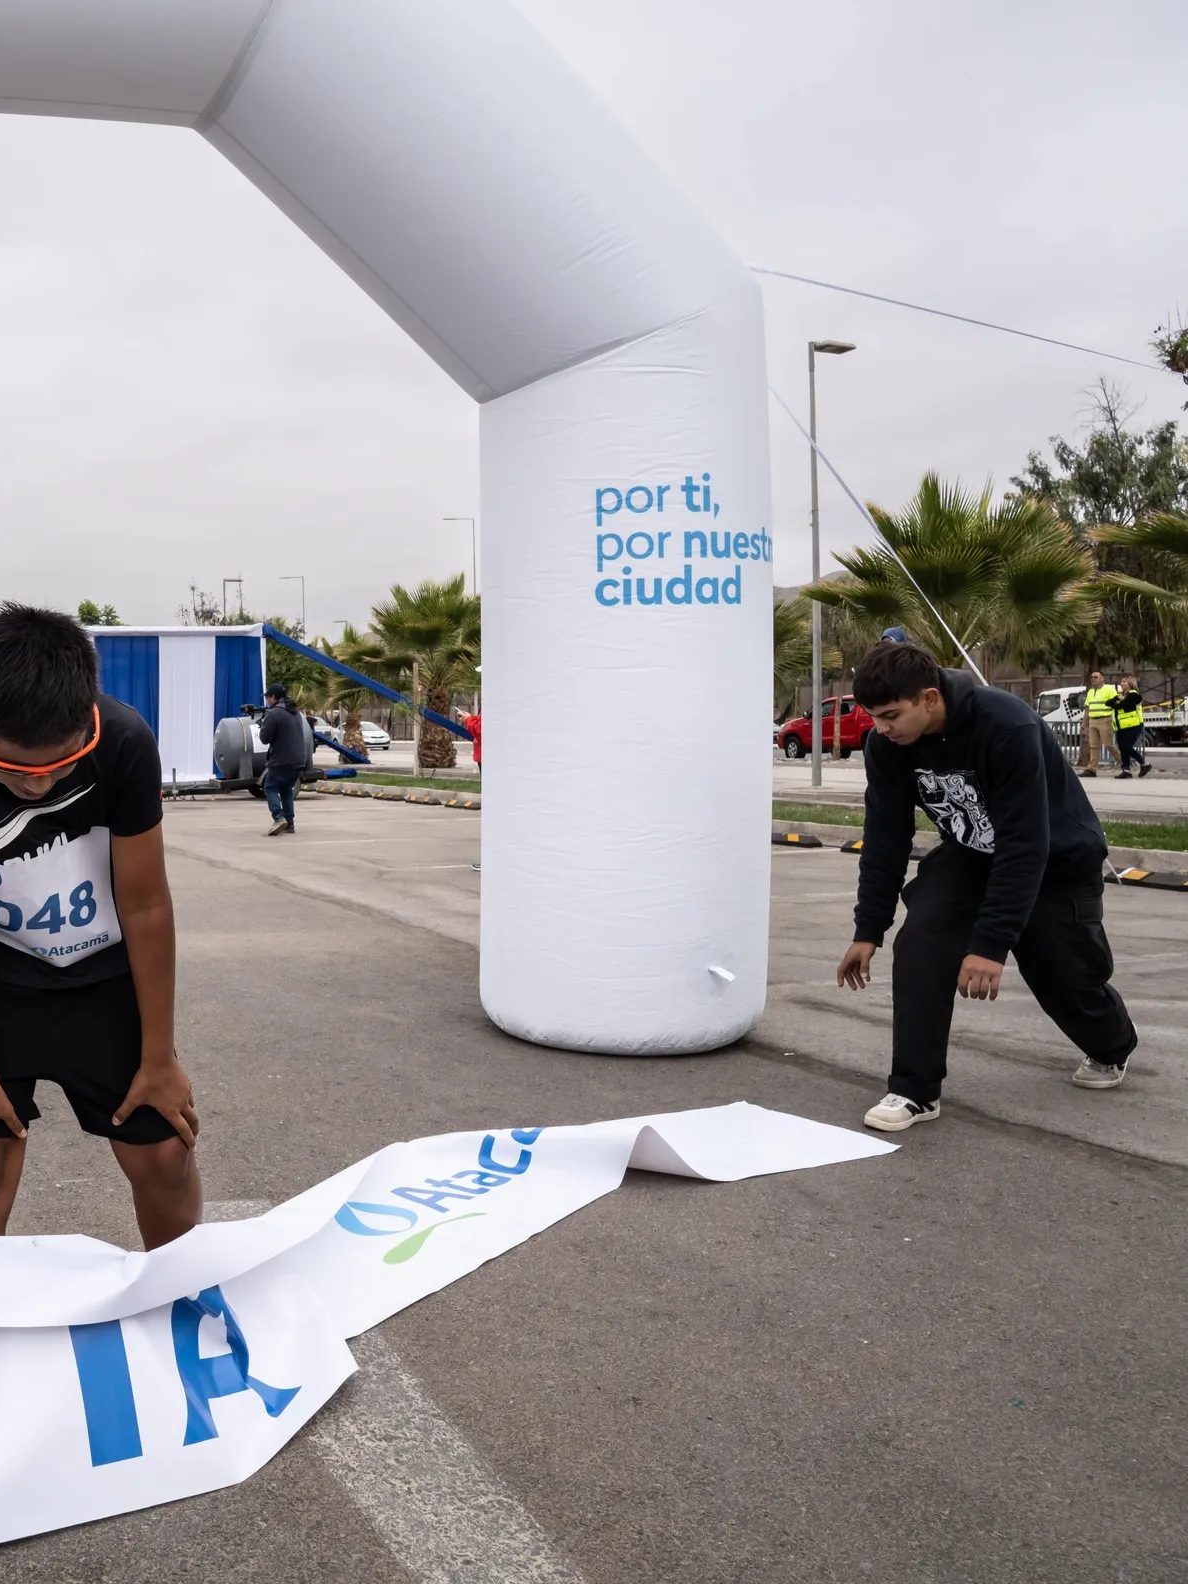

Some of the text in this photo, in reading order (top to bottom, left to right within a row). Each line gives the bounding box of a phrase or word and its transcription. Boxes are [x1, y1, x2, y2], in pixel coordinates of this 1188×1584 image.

[595, 472, 720, 527] por ti,
[596, 526, 773, 573] por nuestr
[594, 564, 742, 607] ciudad
[47, 933, 109, 957] Atacama
